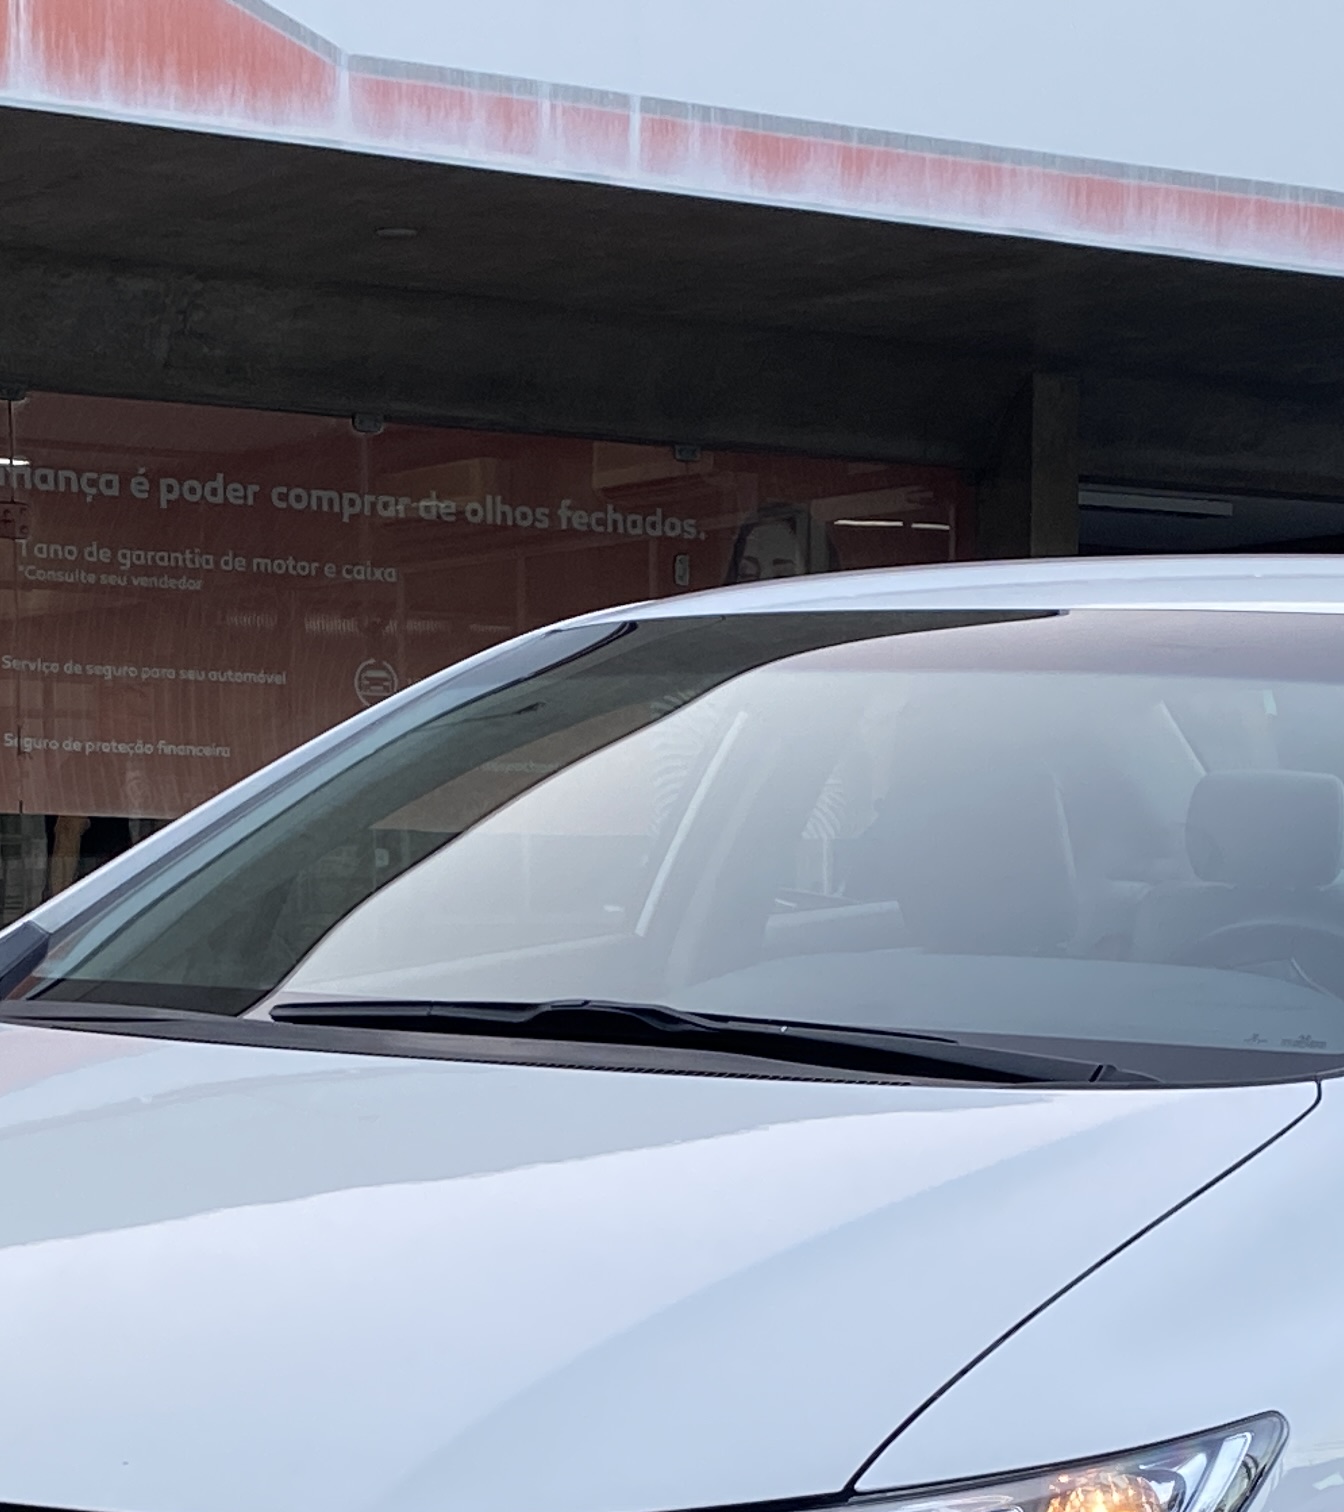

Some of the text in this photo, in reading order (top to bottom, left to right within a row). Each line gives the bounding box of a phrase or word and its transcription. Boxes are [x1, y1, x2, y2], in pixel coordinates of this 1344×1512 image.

[130, 467, 150, 498] é
[159, 472, 260, 509] poder
[271, 484, 411, 523] comprar
[418, 489, 456, 521] de
[465, 494, 549, 529] olhos
[559, 499, 707, 540] fechados.
[33, 543, 78, 560] ano
[83, 541, 112, 562] de
[118, 547, 214, 570] garantia
[220, 550, 246, 571] de
[252, 555, 319, 577] motor
[324, 563, 336, 577] e
[342, 560, 398, 583] caixa
[100, 573, 127, 586] seu
[131, 574, 203, 591] vendedor
[1, 654, 59, 676] Serviço
[63, 661, 82, 675] de
[86, 664, 138, 681] seguro
[140, 666, 176, 682] para
[62, 735, 82, 752] de
[84, 739, 154, 756] proteção
